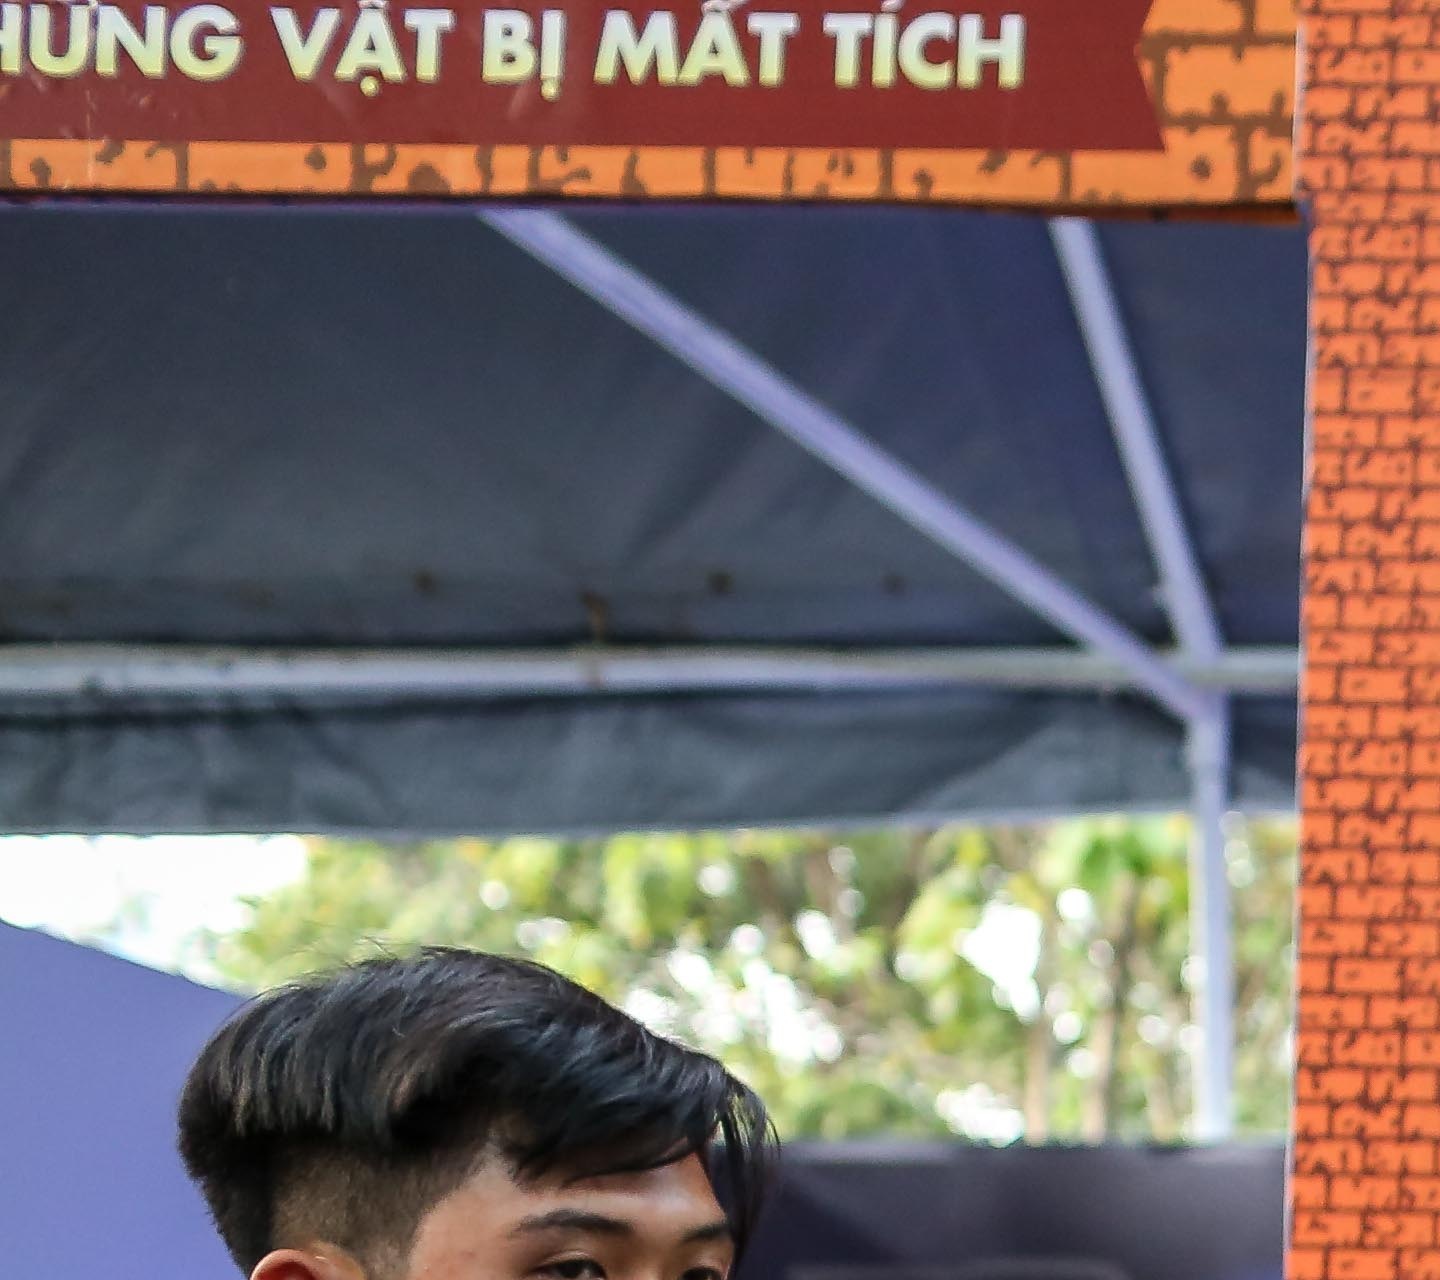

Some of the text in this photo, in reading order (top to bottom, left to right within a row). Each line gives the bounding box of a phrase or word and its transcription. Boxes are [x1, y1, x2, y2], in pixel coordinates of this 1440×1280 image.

[271, 0, 456, 97] VẬT
[482, 7, 567, 101] BỊ
[593, 0, 800, 88] MẤT
[823, 0, 1028, 89] TÍCH
